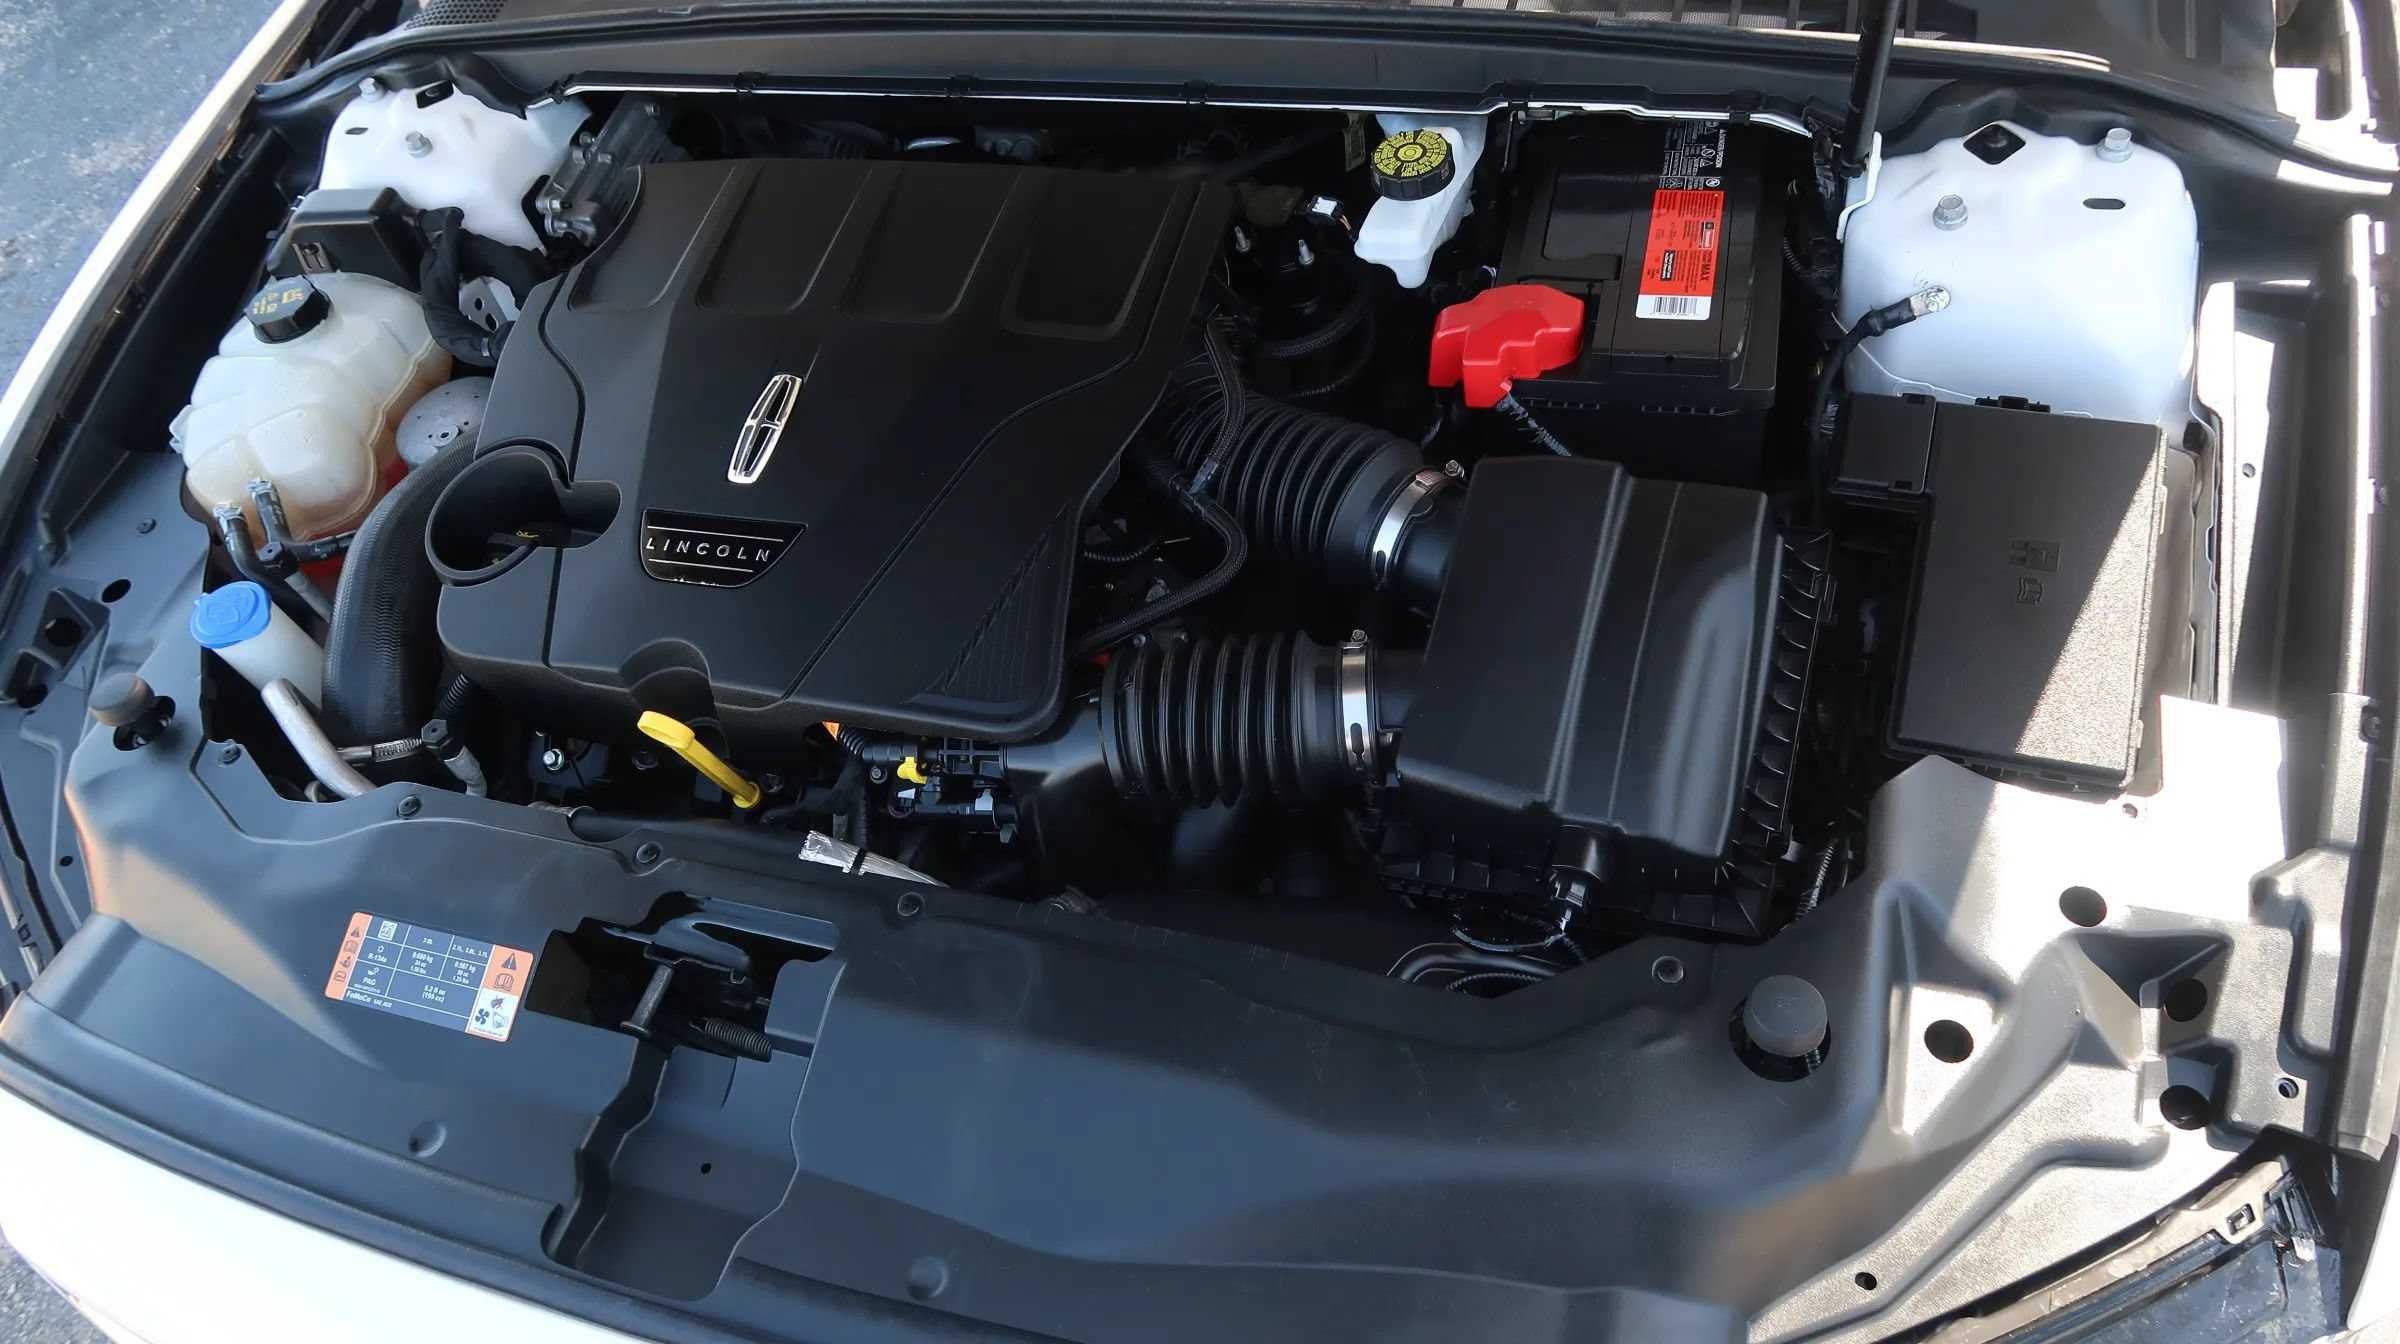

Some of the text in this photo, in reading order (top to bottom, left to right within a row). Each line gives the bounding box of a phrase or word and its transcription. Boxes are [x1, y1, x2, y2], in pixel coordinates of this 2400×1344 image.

[1699, 263, 1713, 281] MAX
[645, 537, 771, 562] LINCOLN
[367, 952, 387, 963] R-134a
[424, 954, 434, 964] kg
[467, 964, 476, 973] kg
[362, 976, 377, 986] PAG
[423, 984, 434, 992] 5.2
[345, 990, 371, 1002] FoMoCo
[433, 994, 445, 1003] cc)
